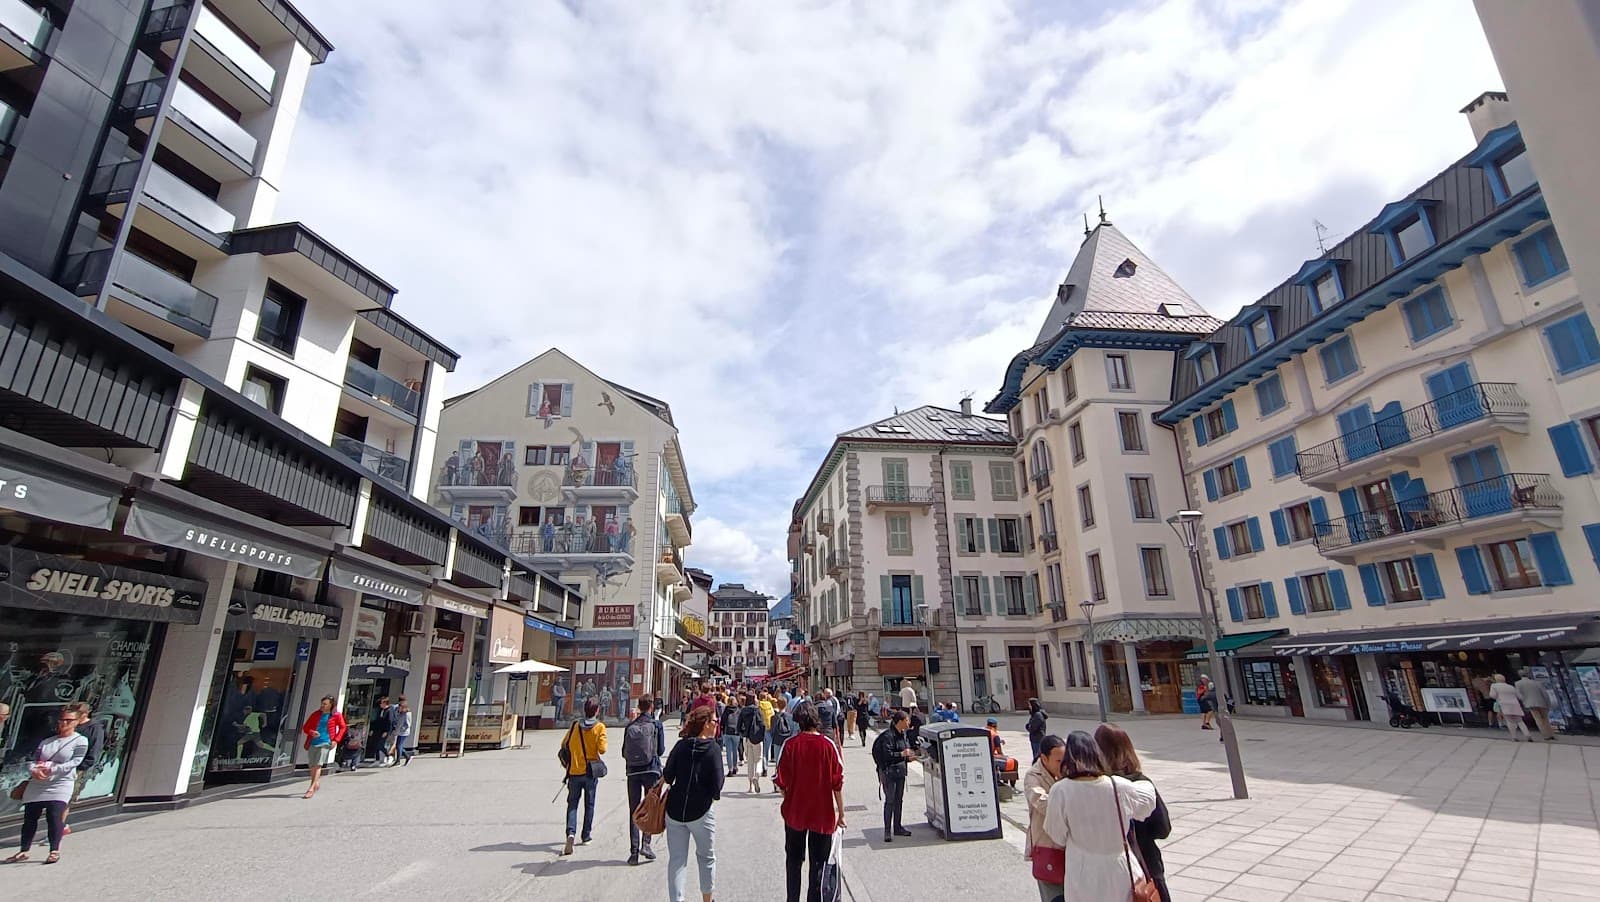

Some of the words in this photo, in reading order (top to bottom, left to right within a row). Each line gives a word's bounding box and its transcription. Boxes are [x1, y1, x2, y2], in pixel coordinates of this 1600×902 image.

[186, 530, 292, 566] SNELLSPORTS
[27, 567, 102, 599] SNELL
[101, 580, 175, 608] SPORTS
[352, 575, 408, 597] SNELLSPORTS
[252, 604, 289, 624] SNELL
[287, 609, 327, 629] SPORTS
[1400, 641, 1423, 651] Presse
[377, 653, 386, 666] de
